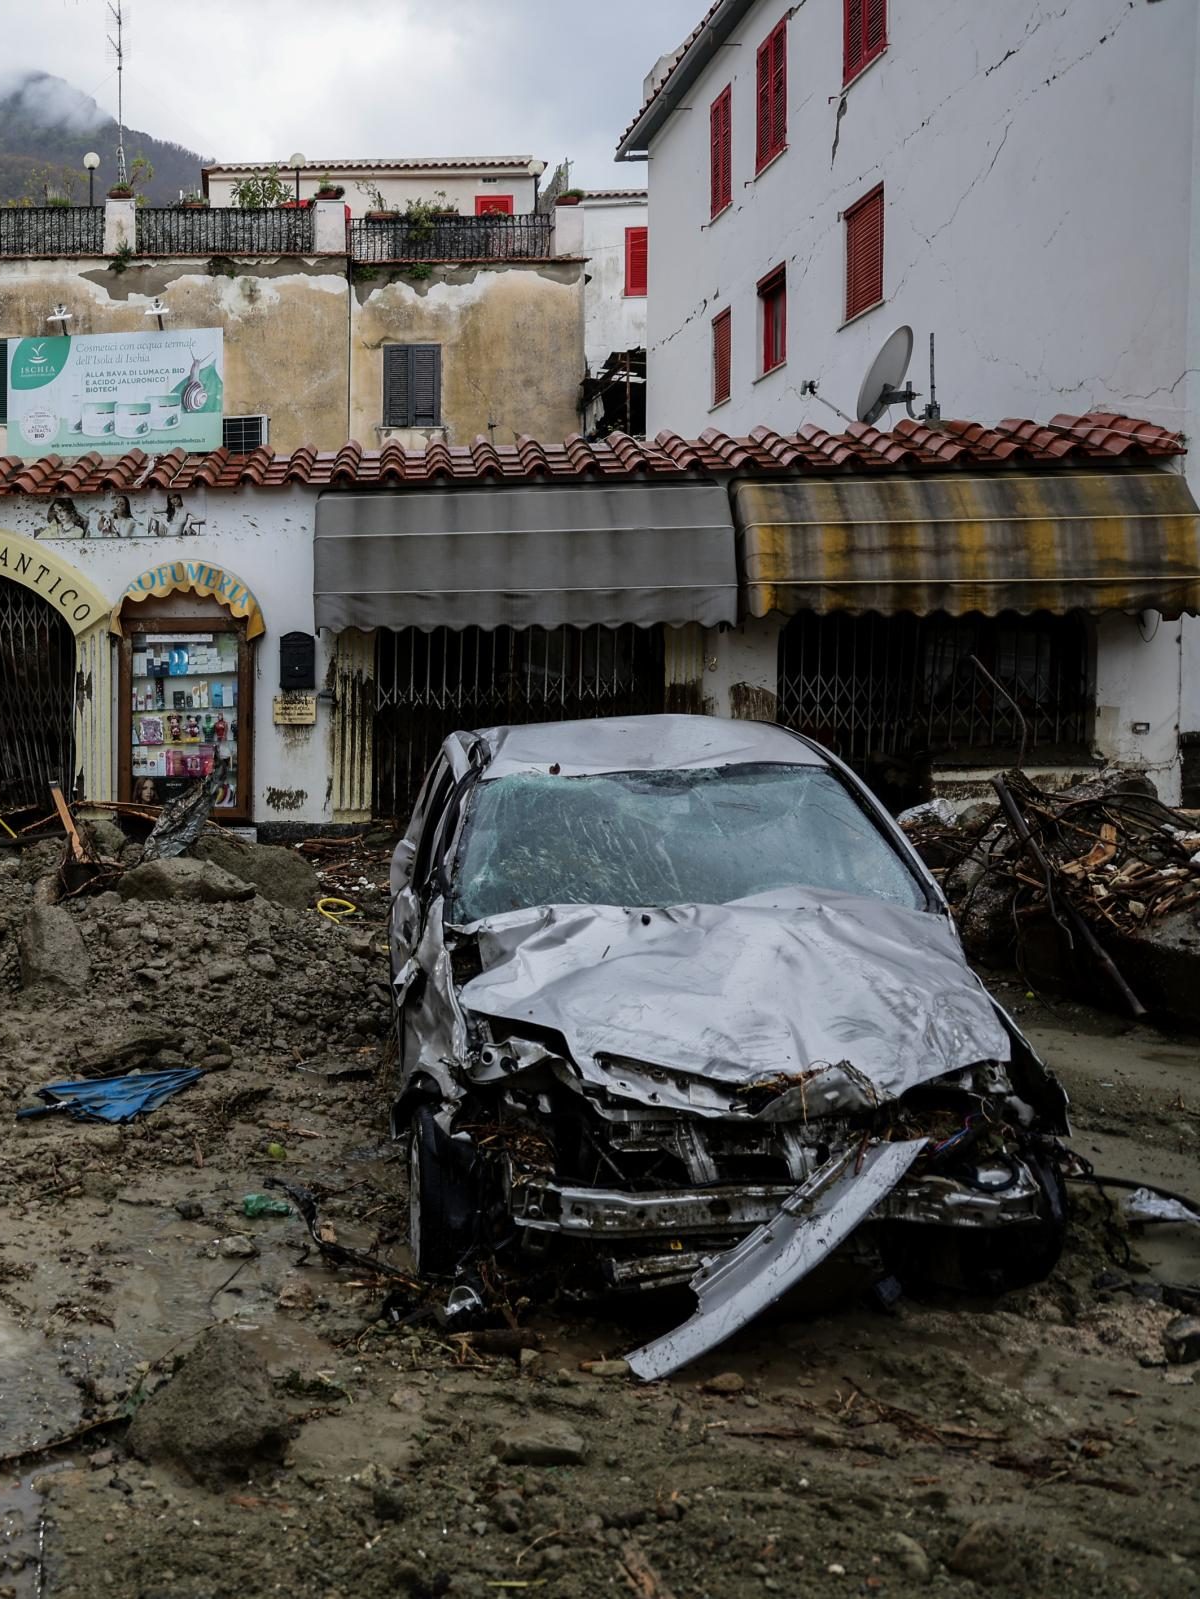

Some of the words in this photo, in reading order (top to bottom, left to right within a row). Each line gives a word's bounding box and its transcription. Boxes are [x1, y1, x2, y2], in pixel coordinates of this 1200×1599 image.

[119, 343, 135, 351] con
[136, 342, 162, 353] acqua
[164, 339, 197, 349] termale
[117, 353, 124, 364] di
[125, 353, 151, 364] Ischia
[20, 365, 56, 374] ISCHIA
[138, 368, 169, 376] LUMACA
[92, 378, 116, 386] ACIDO
[126, 561, 250, 609] OFUMERIA
